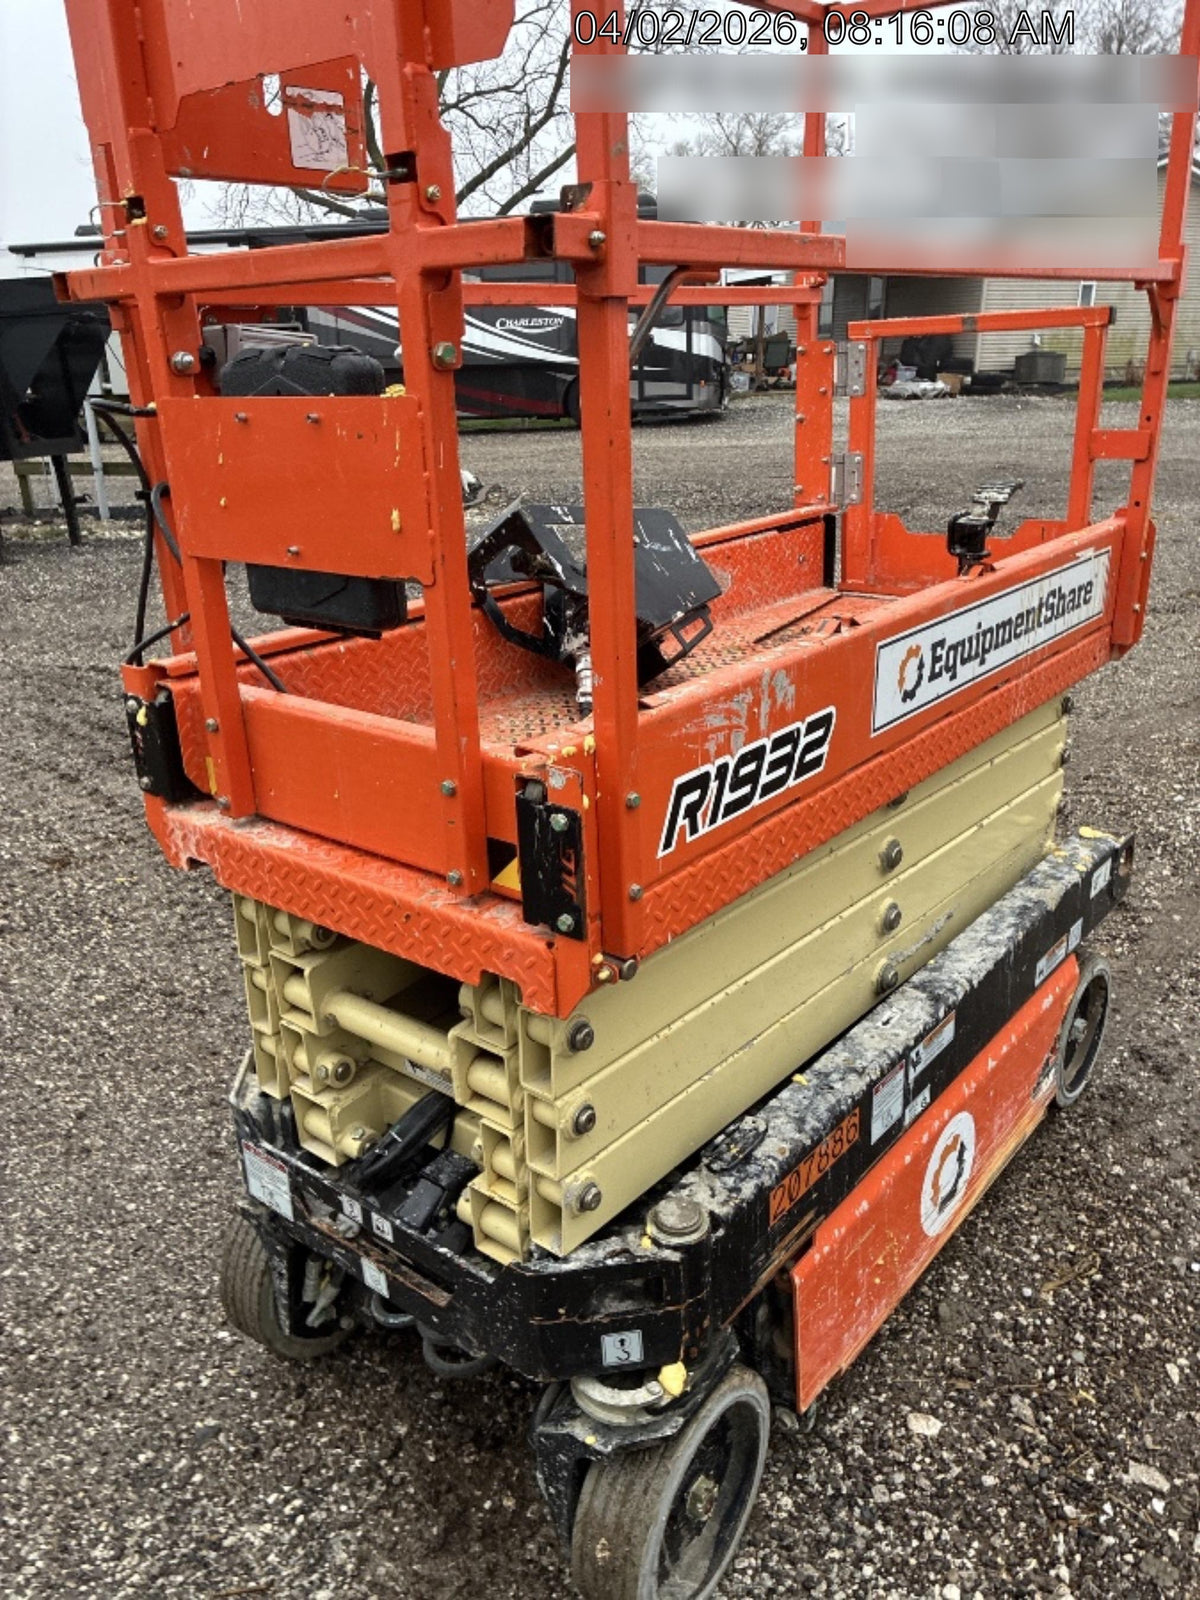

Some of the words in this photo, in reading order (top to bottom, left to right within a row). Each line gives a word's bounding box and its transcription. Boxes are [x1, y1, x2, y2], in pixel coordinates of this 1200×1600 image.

[495, 317, 564, 332] CHARLESTON
[928, 580, 1094, 683] EquipmentShare
[657, 706, 836, 859] R1932
[772, 1112, 858, 1221] 207886
